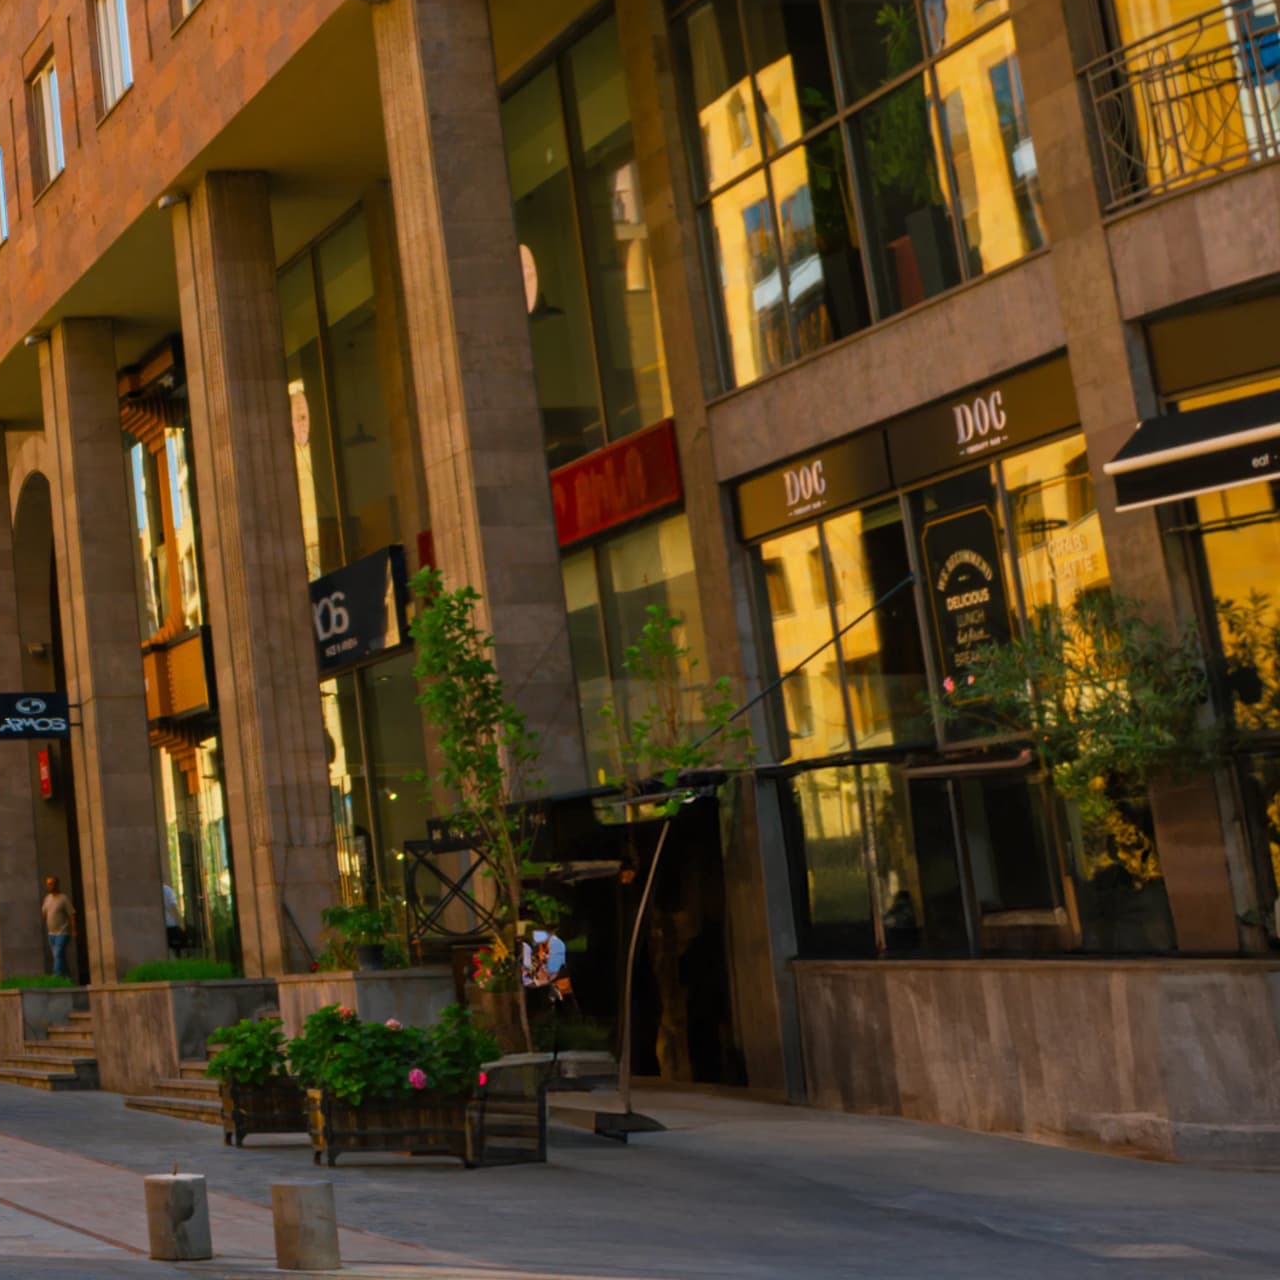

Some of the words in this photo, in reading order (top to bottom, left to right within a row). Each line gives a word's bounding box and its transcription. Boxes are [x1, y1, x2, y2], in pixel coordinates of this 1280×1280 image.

[953, 390, 1007, 444] DOC
[783, 460, 826, 506] DOC
[946, 587, 990, 611] DELICIOUS
[0, 718, 67, 732] ARMOS
